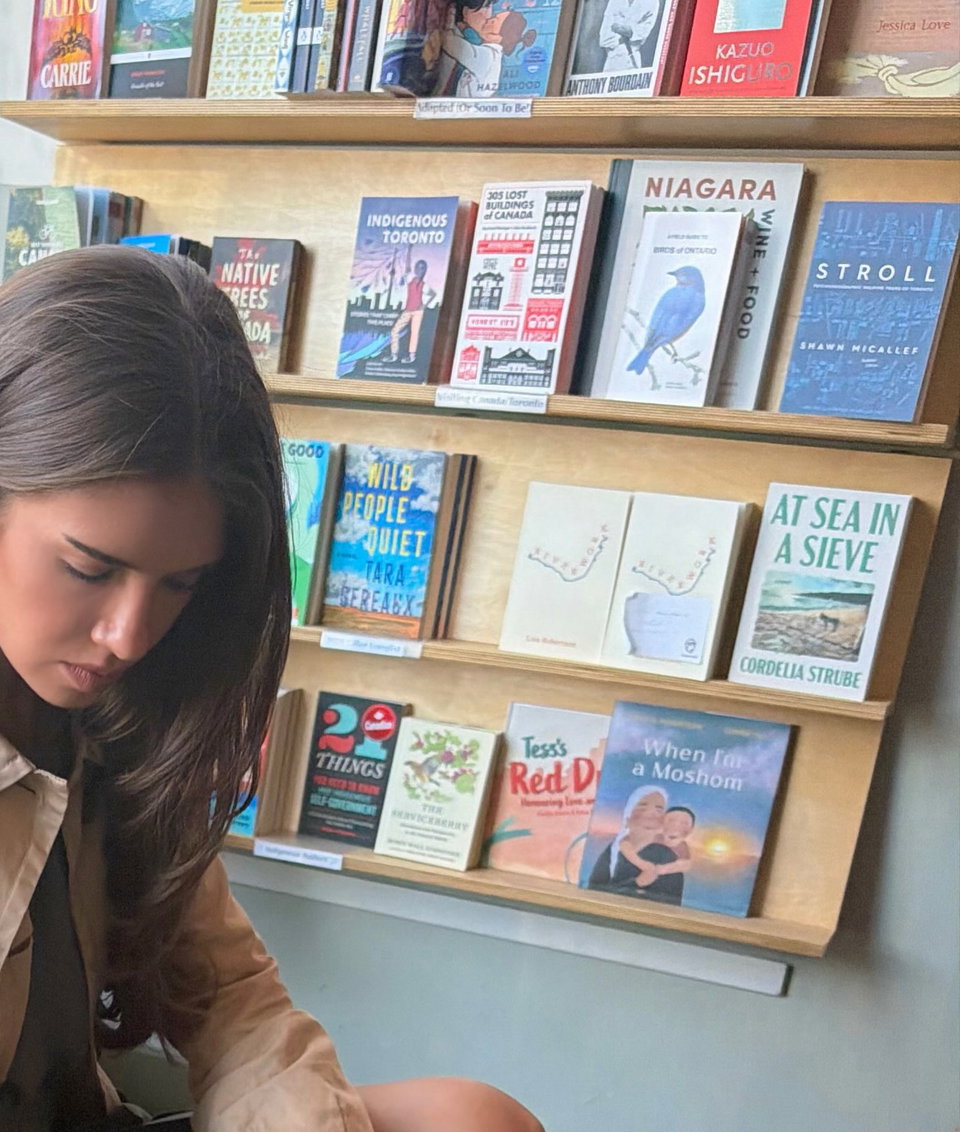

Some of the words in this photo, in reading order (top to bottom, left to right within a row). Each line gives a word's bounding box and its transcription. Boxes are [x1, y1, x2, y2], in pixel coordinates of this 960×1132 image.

[877, 20, 916, 32] Jessica
[921, 19, 951, 31] Love
[715, 41, 775, 60] KAZUO
[40, 60, 92, 88] CARRIE
[566, 78, 607, 96] ANTHONY
[607, 72, 653, 93] BOURDAIN
[688, 62, 793, 85] ISHIGURO
[476, 80, 540, 92] HAZELWOOD
[473, 101, 499, 113] Soon
[501, 101, 513, 113] To
[486, 191, 504, 200] 305
[505, 190, 529, 200] LOST
[644, 177, 777, 201] NIAGARA
[485, 200, 535, 210] BUILDINGS
[494, 210, 533, 220] CANADA
[366, 213, 448, 228] INDIGENOUS
[382, 230, 446, 244] TORONTO
[753, 208, 776, 260] WINE
[221, 263, 281, 286] NATIVE
[815, 262, 936, 283] STROLL
[737, 285, 759, 340] FOOD
[799, 341, 845, 352] SHAWN
[851, 345, 919, 355] MICALLEF
[288, 443, 325, 459] GOOD
[366, 462, 415, 491] WILD
[342, 491, 409, 523] PEOPLE
[770, 493, 808, 526] AT
[810, 496, 860, 533] SEA
[868, 502, 901, 537] IN
[367, 526, 428, 559] QUIET
[773, 532, 792, 564] A
[799, 535, 879, 574] SIEVE
[365, 560, 406, 587] TARA
[740, 656, 805, 682] CORDELIA
[807, 665, 864, 689] STRUBE
[521, 735, 568, 759] Tess's
[643, 738, 707, 764] When
[316, 751, 386, 780] THINGS
[509, 760, 569, 795] Red
[573, 756, 602, 794] D
[632, 763, 644, 777] a
[652, 762, 745, 792] Moshom
